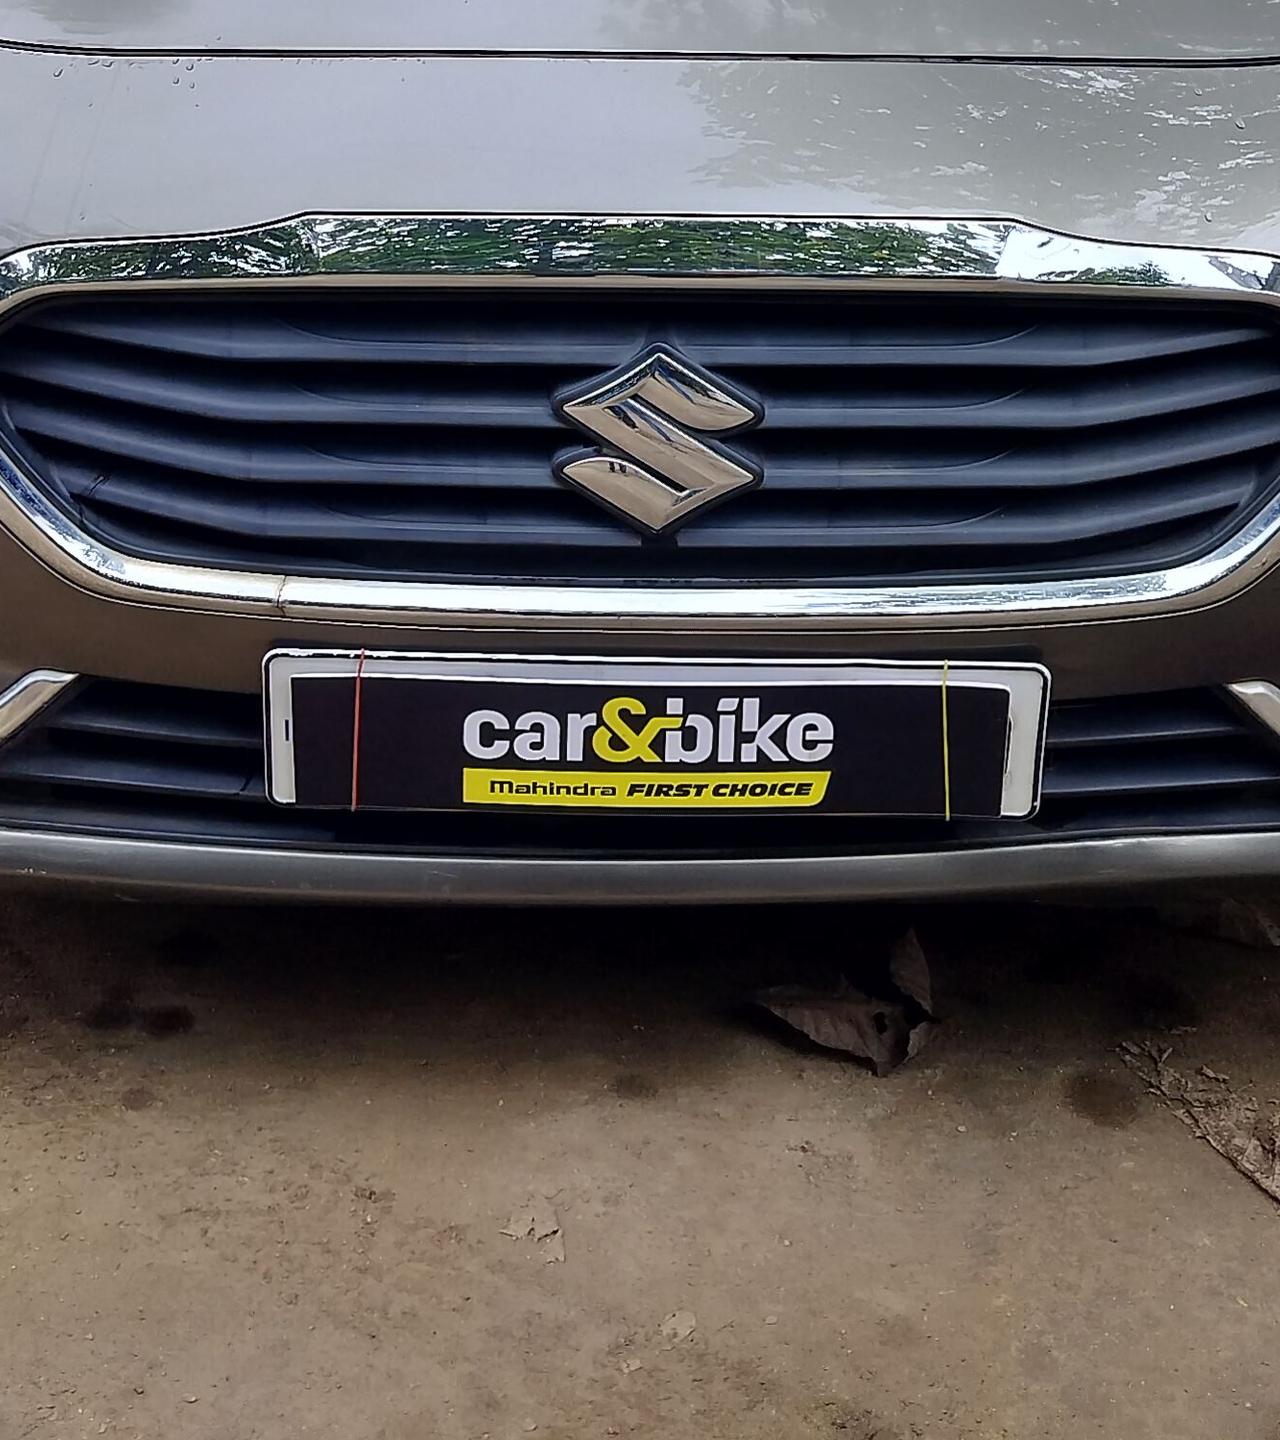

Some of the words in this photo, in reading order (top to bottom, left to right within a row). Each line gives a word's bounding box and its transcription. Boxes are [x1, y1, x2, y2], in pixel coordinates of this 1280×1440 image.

[463, 697, 835, 763] car&bike
[489, 779, 617, 797] Mahindra
[626, 782, 709, 798] FIRST
[716, 781, 814, 798] CHOICE
